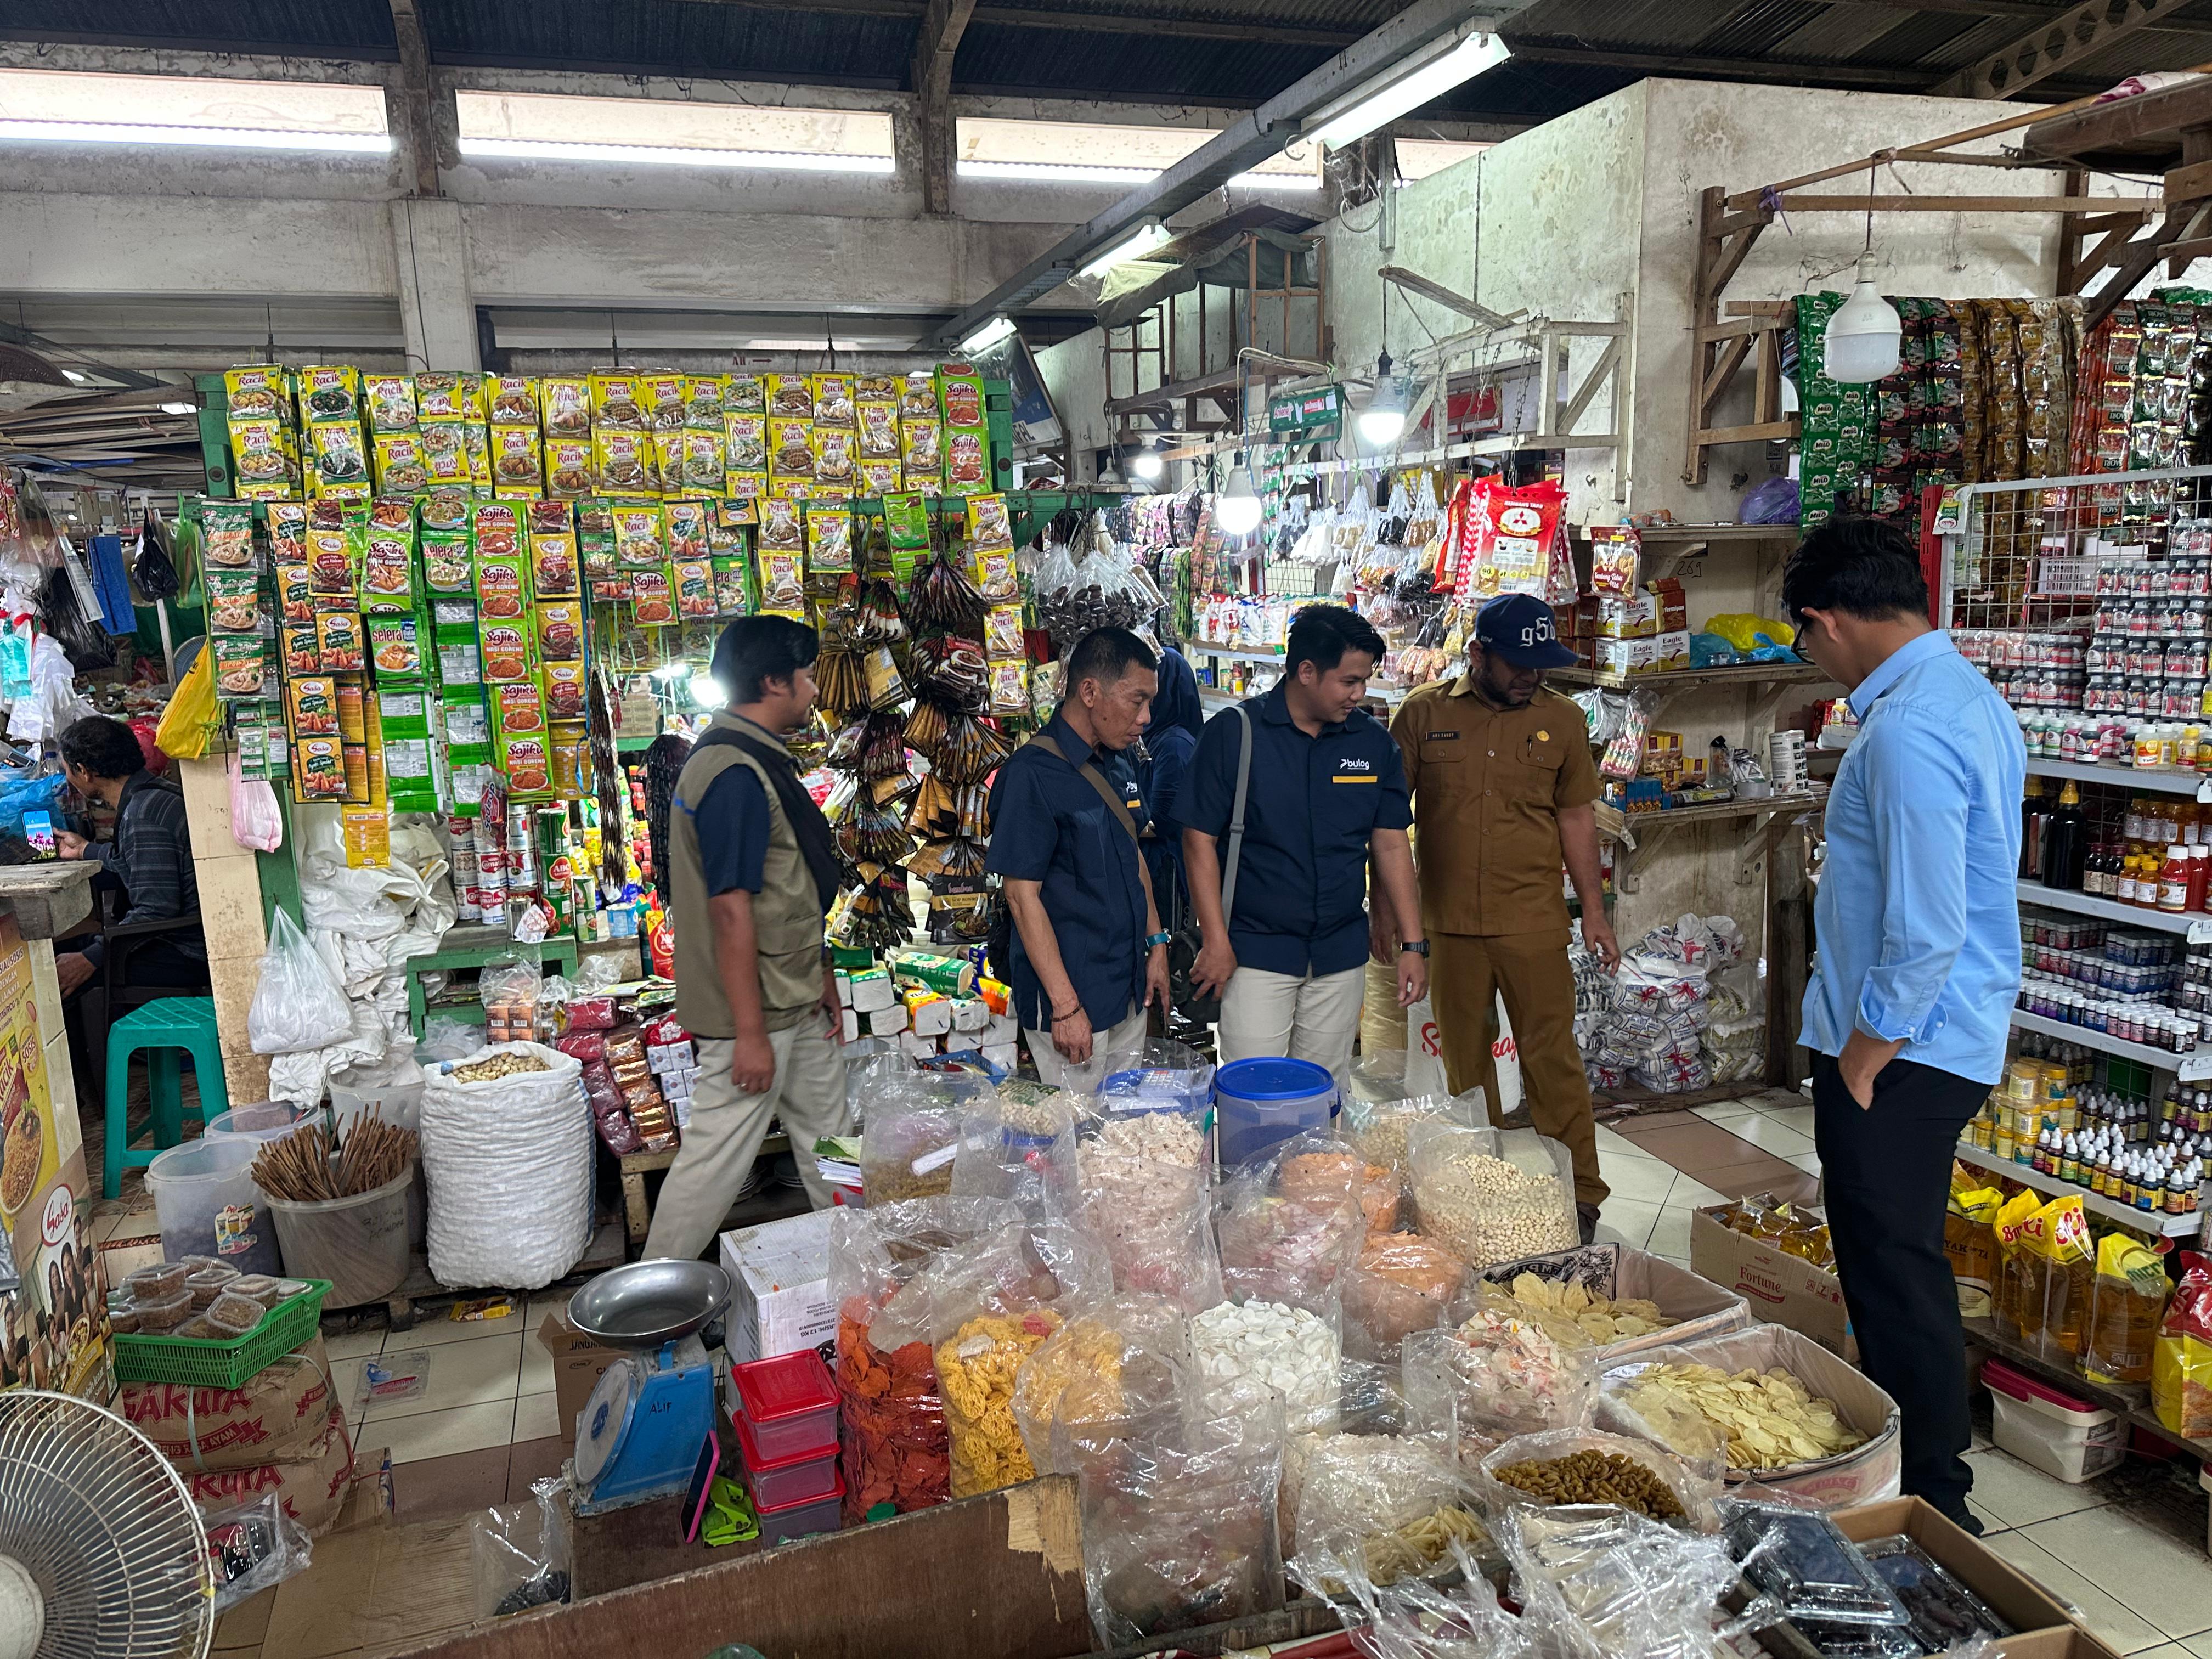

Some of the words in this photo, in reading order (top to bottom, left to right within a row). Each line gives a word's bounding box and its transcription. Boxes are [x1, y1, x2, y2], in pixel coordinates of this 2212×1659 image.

[238, 375, 267, 385] Racik
[313, 374, 341, 386] Racik
[500, 379, 527, 390] Racik
[778, 375, 803, 383] Racik
[606, 386, 631, 398] Racik
[655, 386, 680, 399] Racik
[693, 386, 720, 398] Racik
[821, 383, 845, 393] Racik
[946, 384, 977, 398] Sajiku
[244, 435, 273, 447] Racik
[781, 430, 806, 441] Racik
[503, 438, 529, 450] Racik
[822, 441, 846, 452] Racik
[950, 438, 980, 450] Sajiku
[388, 446, 416, 460] Racik
[557, 452, 584, 464] Racik
[735, 483, 758, 493] Racik
[477, 505, 515, 521] Sajiku
[769, 502, 793, 513] Racik
[977, 504, 1001, 517] Racik
[770, 563, 795, 575] Racik
[1677, 560, 1702, 578] 269
[481, 567, 518, 584] Sajiku
[634, 575, 667, 590] Sajiku
[1627, 601, 1647, 611] Eagle
[1664, 605, 1684, 613] fermipan
[992, 616, 1014, 627] Racik
[486, 630, 522, 646] Sajiku
[1663, 635, 1682, 645] Eagle
[1633, 644, 1653, 653] Eagle
[508, 745, 544, 759] Sajiku
[1347, 758, 1370, 771] bulog
[10, 946, 24, 966] SOSIS
[22, 1039, 36, 1063] SOSIS
[1739, 1266, 1782, 1294] Fortune
[210, 1429, 236, 1446] AYAM
